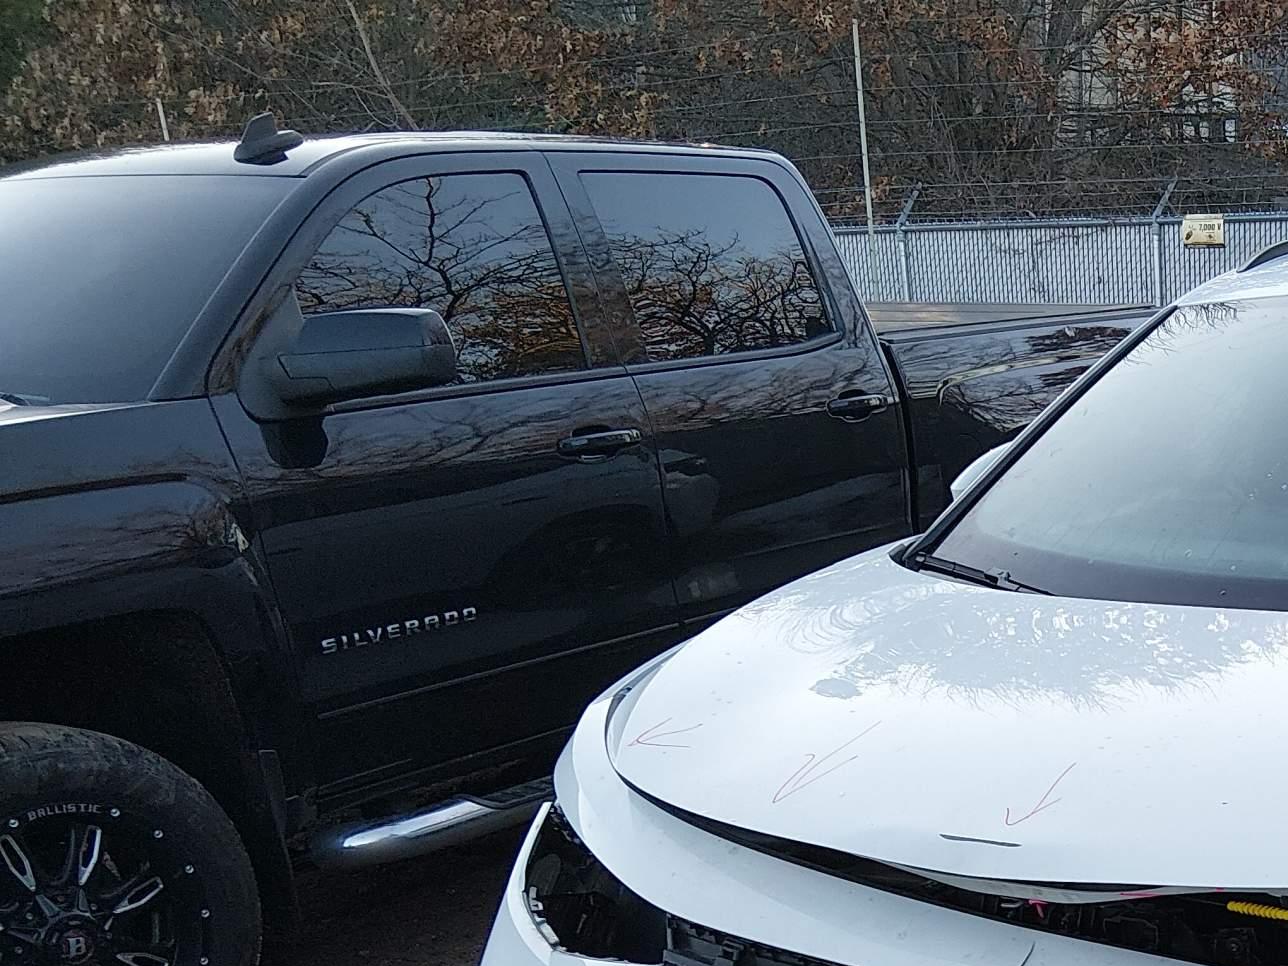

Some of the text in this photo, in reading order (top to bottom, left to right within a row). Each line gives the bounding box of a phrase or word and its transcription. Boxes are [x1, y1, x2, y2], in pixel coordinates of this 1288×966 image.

[1198, 223, 1216, 232] 7,000
[320, 606, 477, 655] SILVERADO
[26, 802, 103, 821] BALLISTIC
